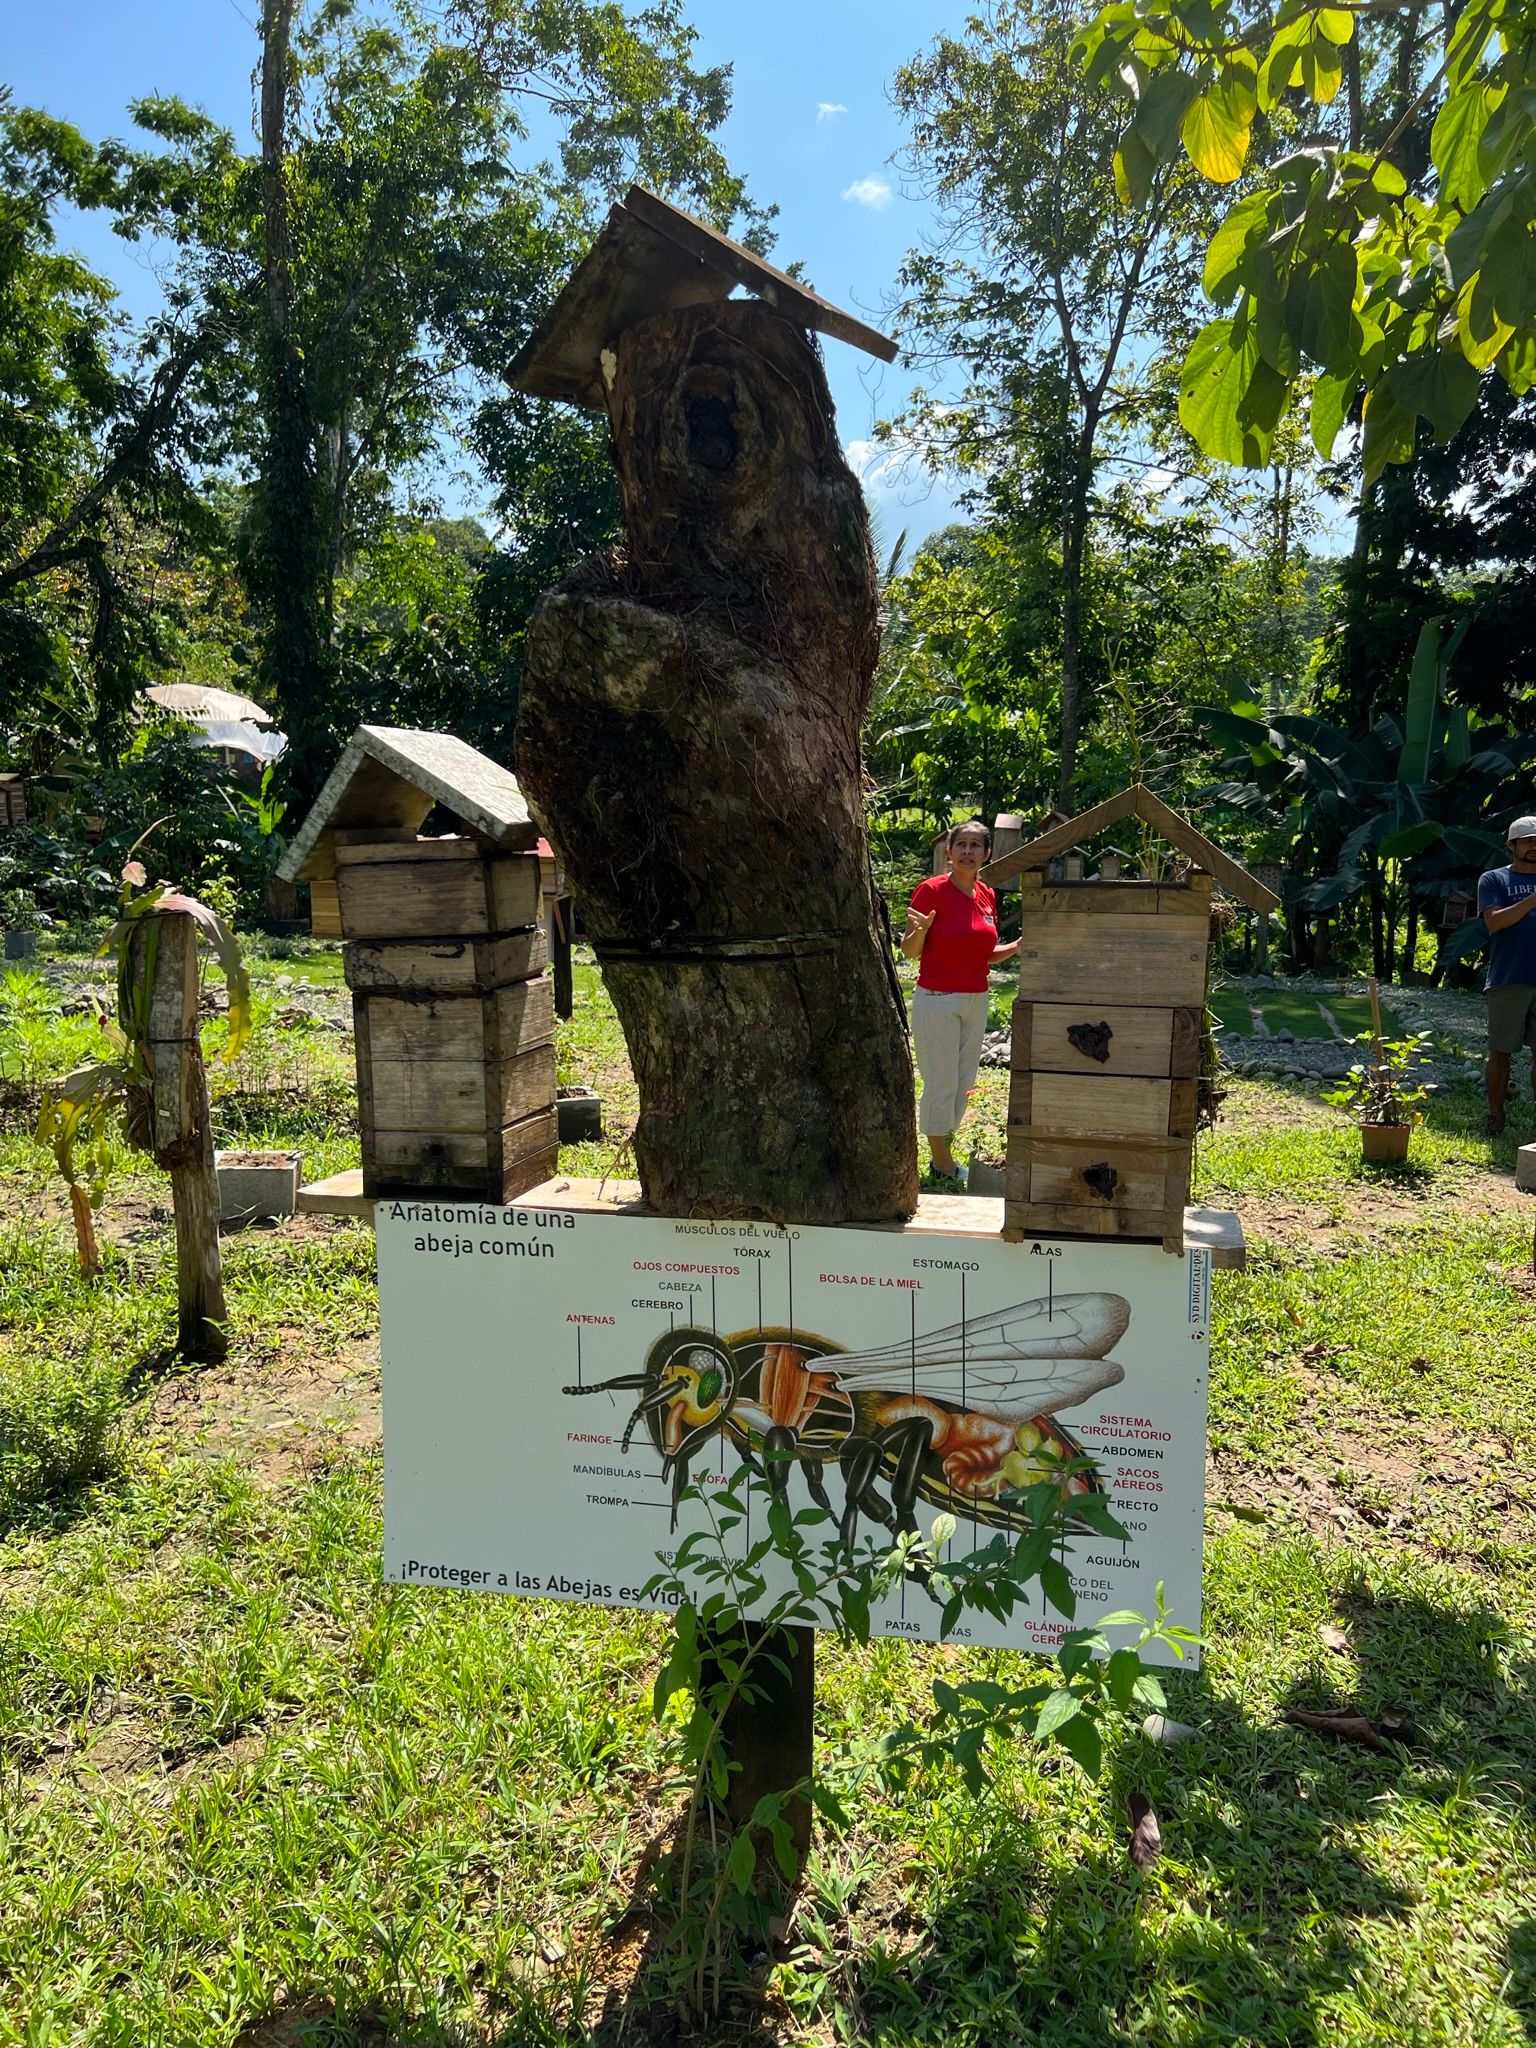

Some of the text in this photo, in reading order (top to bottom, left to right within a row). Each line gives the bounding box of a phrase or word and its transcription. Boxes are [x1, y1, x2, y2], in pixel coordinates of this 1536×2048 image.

[391, 1202, 576, 1229] Anatomía de una
[675, 1224, 800, 1240] MÚSCULOS DEL VUELO
[414, 1233, 555, 1257] abeja común
[1030, 1246, 1062, 1257] ALAS
[733, 1246, 771, 1258] TÓRAX
[633, 1261, 740, 1275] OJOS COMPUESTOS
[913, 1258, 980, 1271] ESTOMAGO
[658, 1281, 702, 1292] CABEZA
[819, 1274, 924, 1289] BOLSA DE LA MIEL
[631, 1299, 684, 1310] CEREBRO
[566, 1314, 616, 1325] ANTENAS
[1099, 1415, 1153, 1428] SISTEMA
[567, 1433, 612, 1444] FARINGE
[1080, 1425, 1171, 1441] CIRCULATORIO
[1101, 1446, 1164, 1459] ABDOMEN
[573, 1464, 641, 1479] MANDÍBULAS
[1117, 1467, 1160, 1479] SACOS
[1112, 1478, 1163, 1492] AÉREOS
[586, 1495, 630, 1507] TROMPA
[1117, 1500, 1159, 1512] RECTO
[1086, 1555, 1140, 1569] AGUIJÓN
[401, 1560, 491, 1586] ¡Proteger
[497, 1574, 508, 1586] a
[515, 1571, 541, 1590] las
[546, 1574, 612, 1599] Abejas
[619, 1586, 640, 1601] es
[1091, 1579, 1114, 1590] DEL
[1074, 1590, 1108, 1602] NENO
[885, 1620, 921, 1632] PATAS
